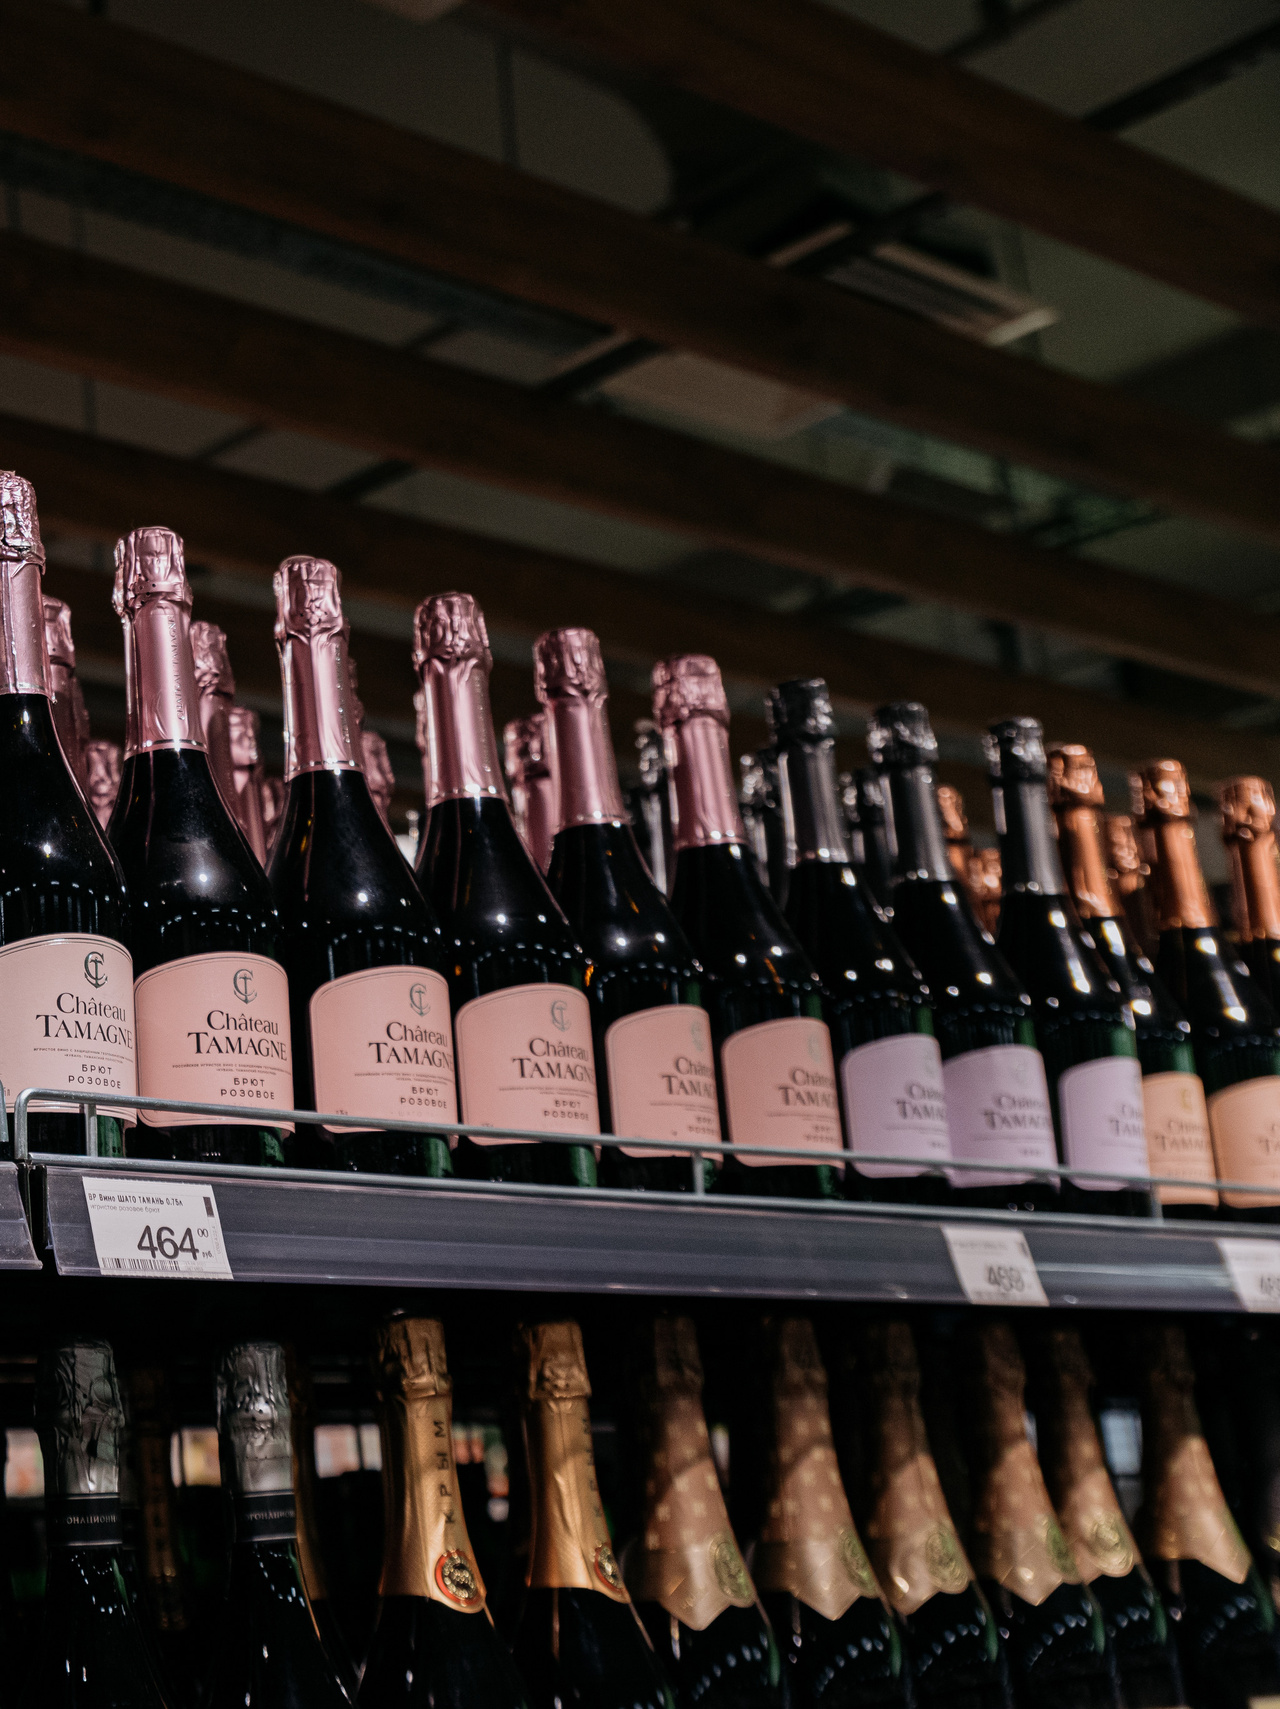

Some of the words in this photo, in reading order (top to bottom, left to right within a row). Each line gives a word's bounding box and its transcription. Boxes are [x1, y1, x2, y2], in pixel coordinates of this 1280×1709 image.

[56, 992, 126, 1022] Château
[35, 1014, 133, 1050] TAMAGNE
[207, 1010, 279, 1036] Château
[386, 1021, 448, 1047] Château
[187, 1032, 288, 1061] TAMAGNE
[529, 1037, 589, 1061] Château
[81, 1063, 112, 1075] БРЮТ
[68, 1075, 121, 1089] РОЗОВОЕ
[233, 1077, 265, 1088] БРЮТ
[411, 1086, 439, 1096] БРЮТ
[220, 1088, 275, 1100] РОЗОВОЕ
[400, 1097, 448, 1109] РОЗОВОЕ
[90, 1204, 117, 1212] игристое
[119, 1205, 144, 1213] розовое
[145, 1206, 161, 1214] брют
[99, 1194, 115, 1202] Вино
[117, 1195, 137, 1204] ШАТО
[138, 1196, 165, 1206] ТАМАНЬ
[165, 1198, 184, 1207] 0.75л
[137, 1225, 199, 1260] 464
[197, 1228, 209, 1238] 00
[433, 1420, 455, 1524] КРЫМ
